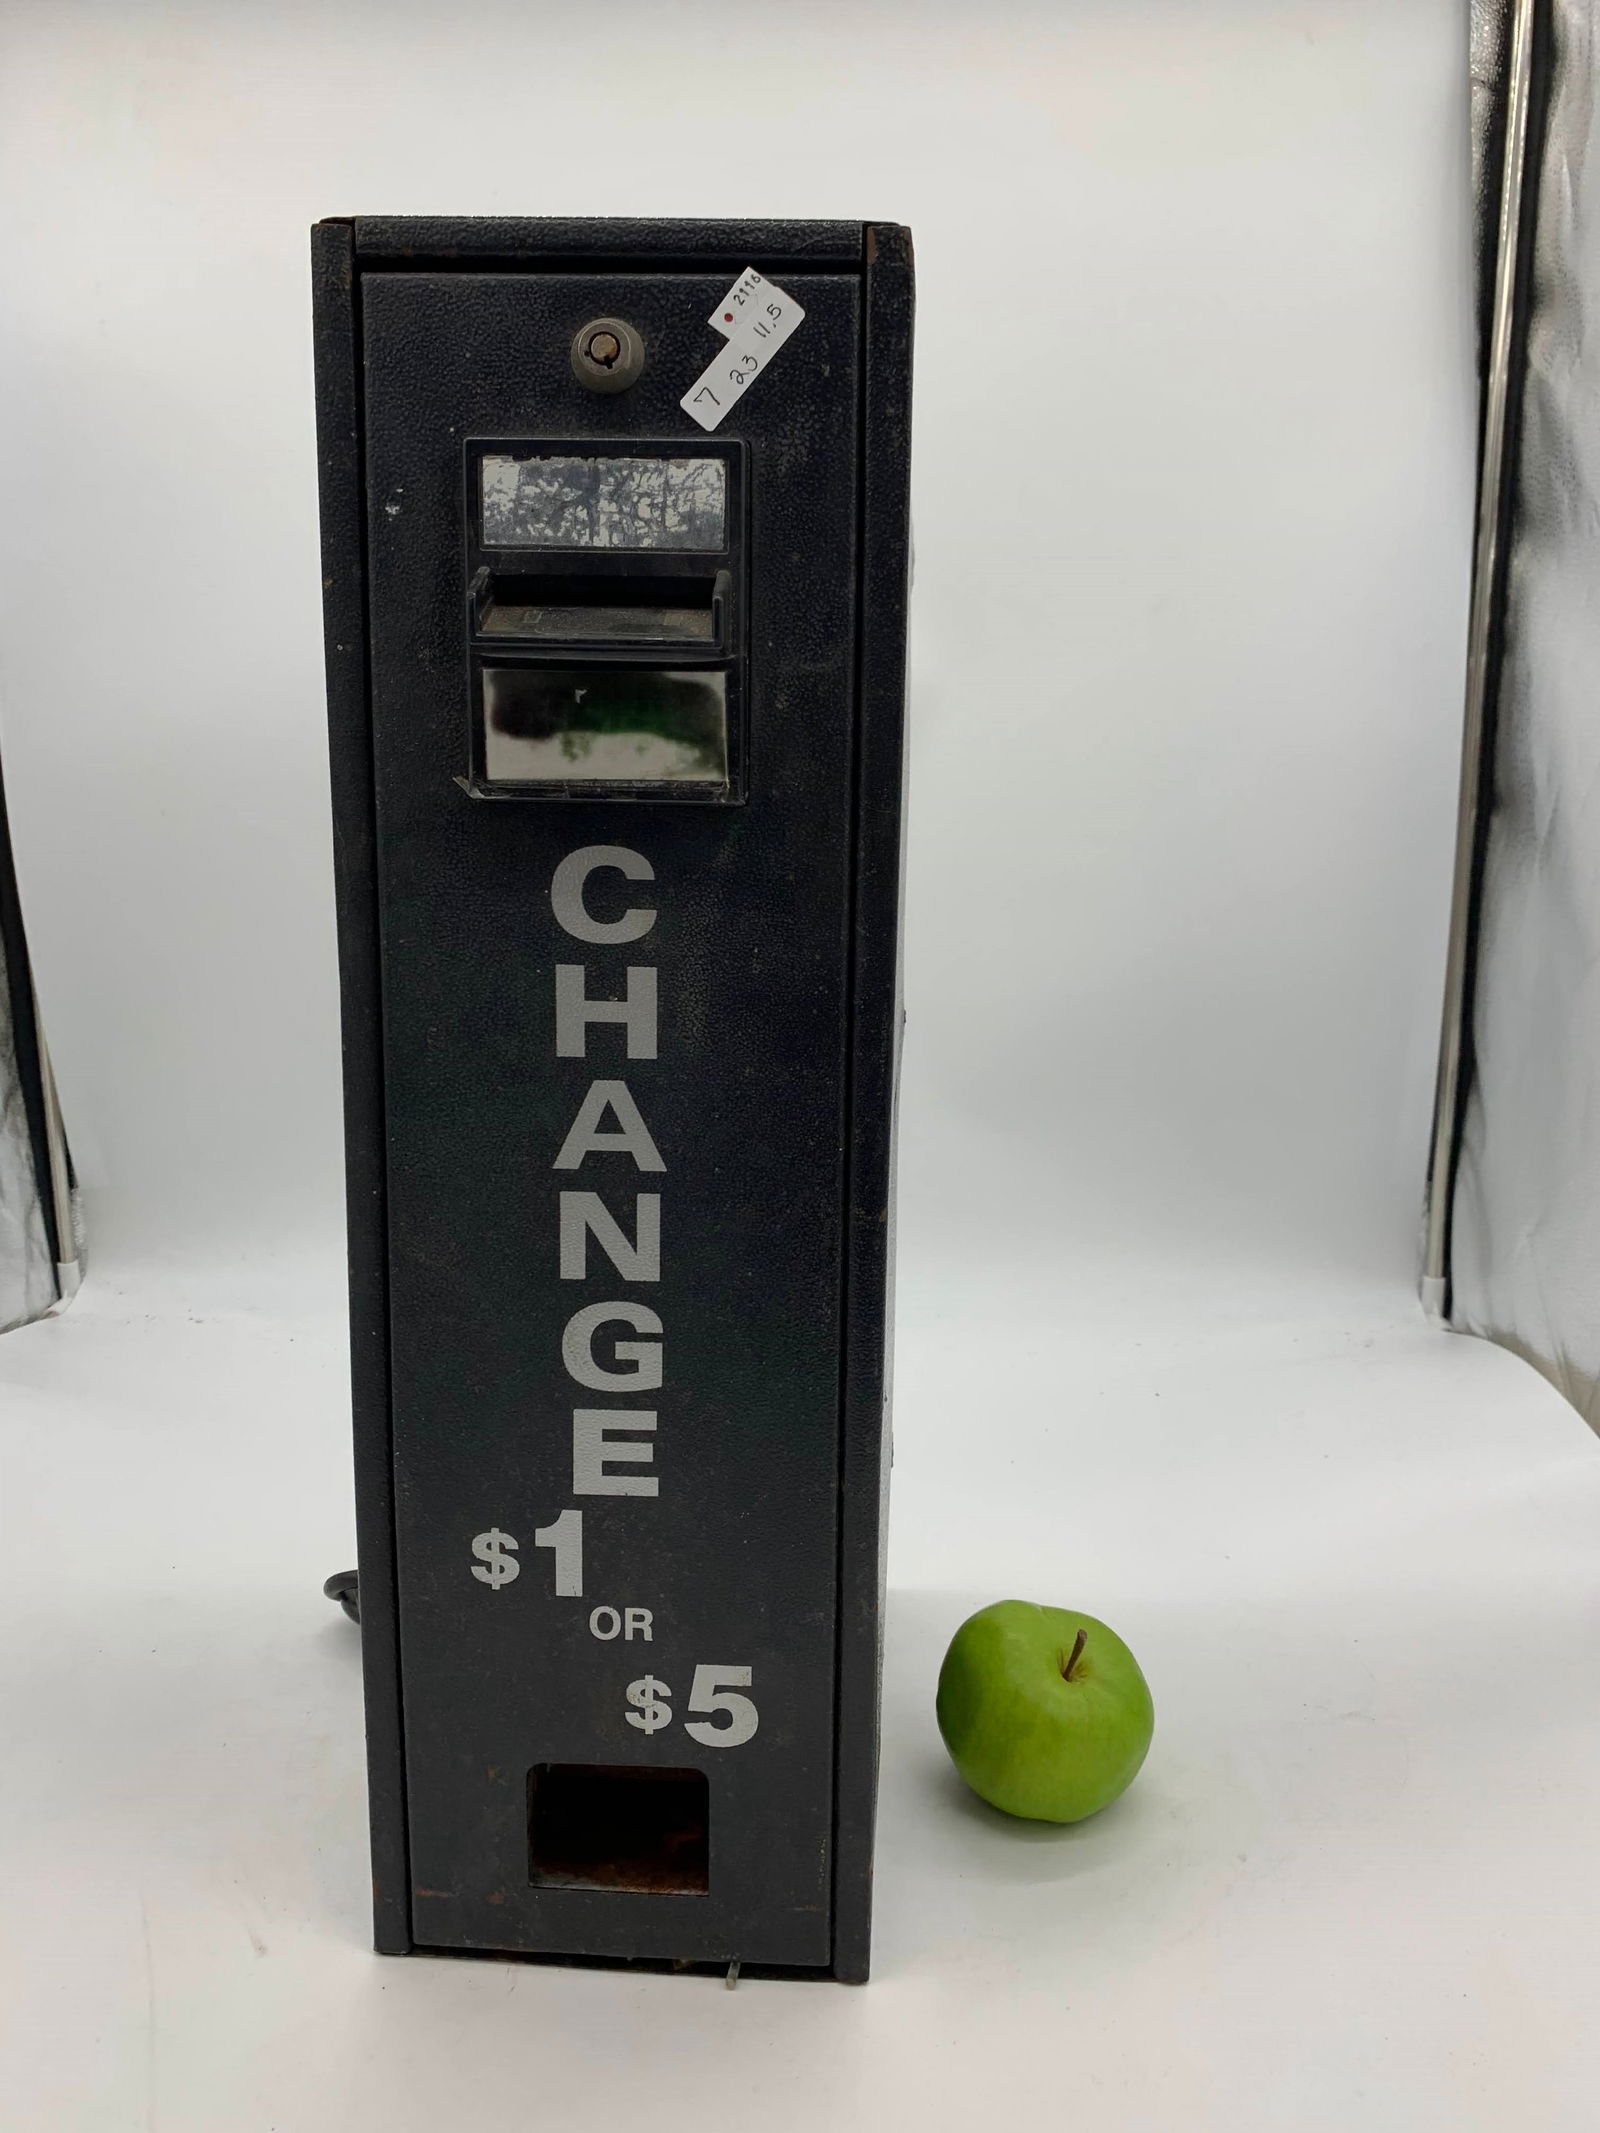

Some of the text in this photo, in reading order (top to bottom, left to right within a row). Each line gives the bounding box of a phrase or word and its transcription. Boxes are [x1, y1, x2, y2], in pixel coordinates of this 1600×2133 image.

[693, 387, 721, 406] 7
[729, 355, 758, 385] 23
[550, 845, 667, 1497] CHANGE
[470, 1509, 583, 1598] $1
[589, 1606, 654, 1642] OR
[624, 1664, 759, 1748] $5
